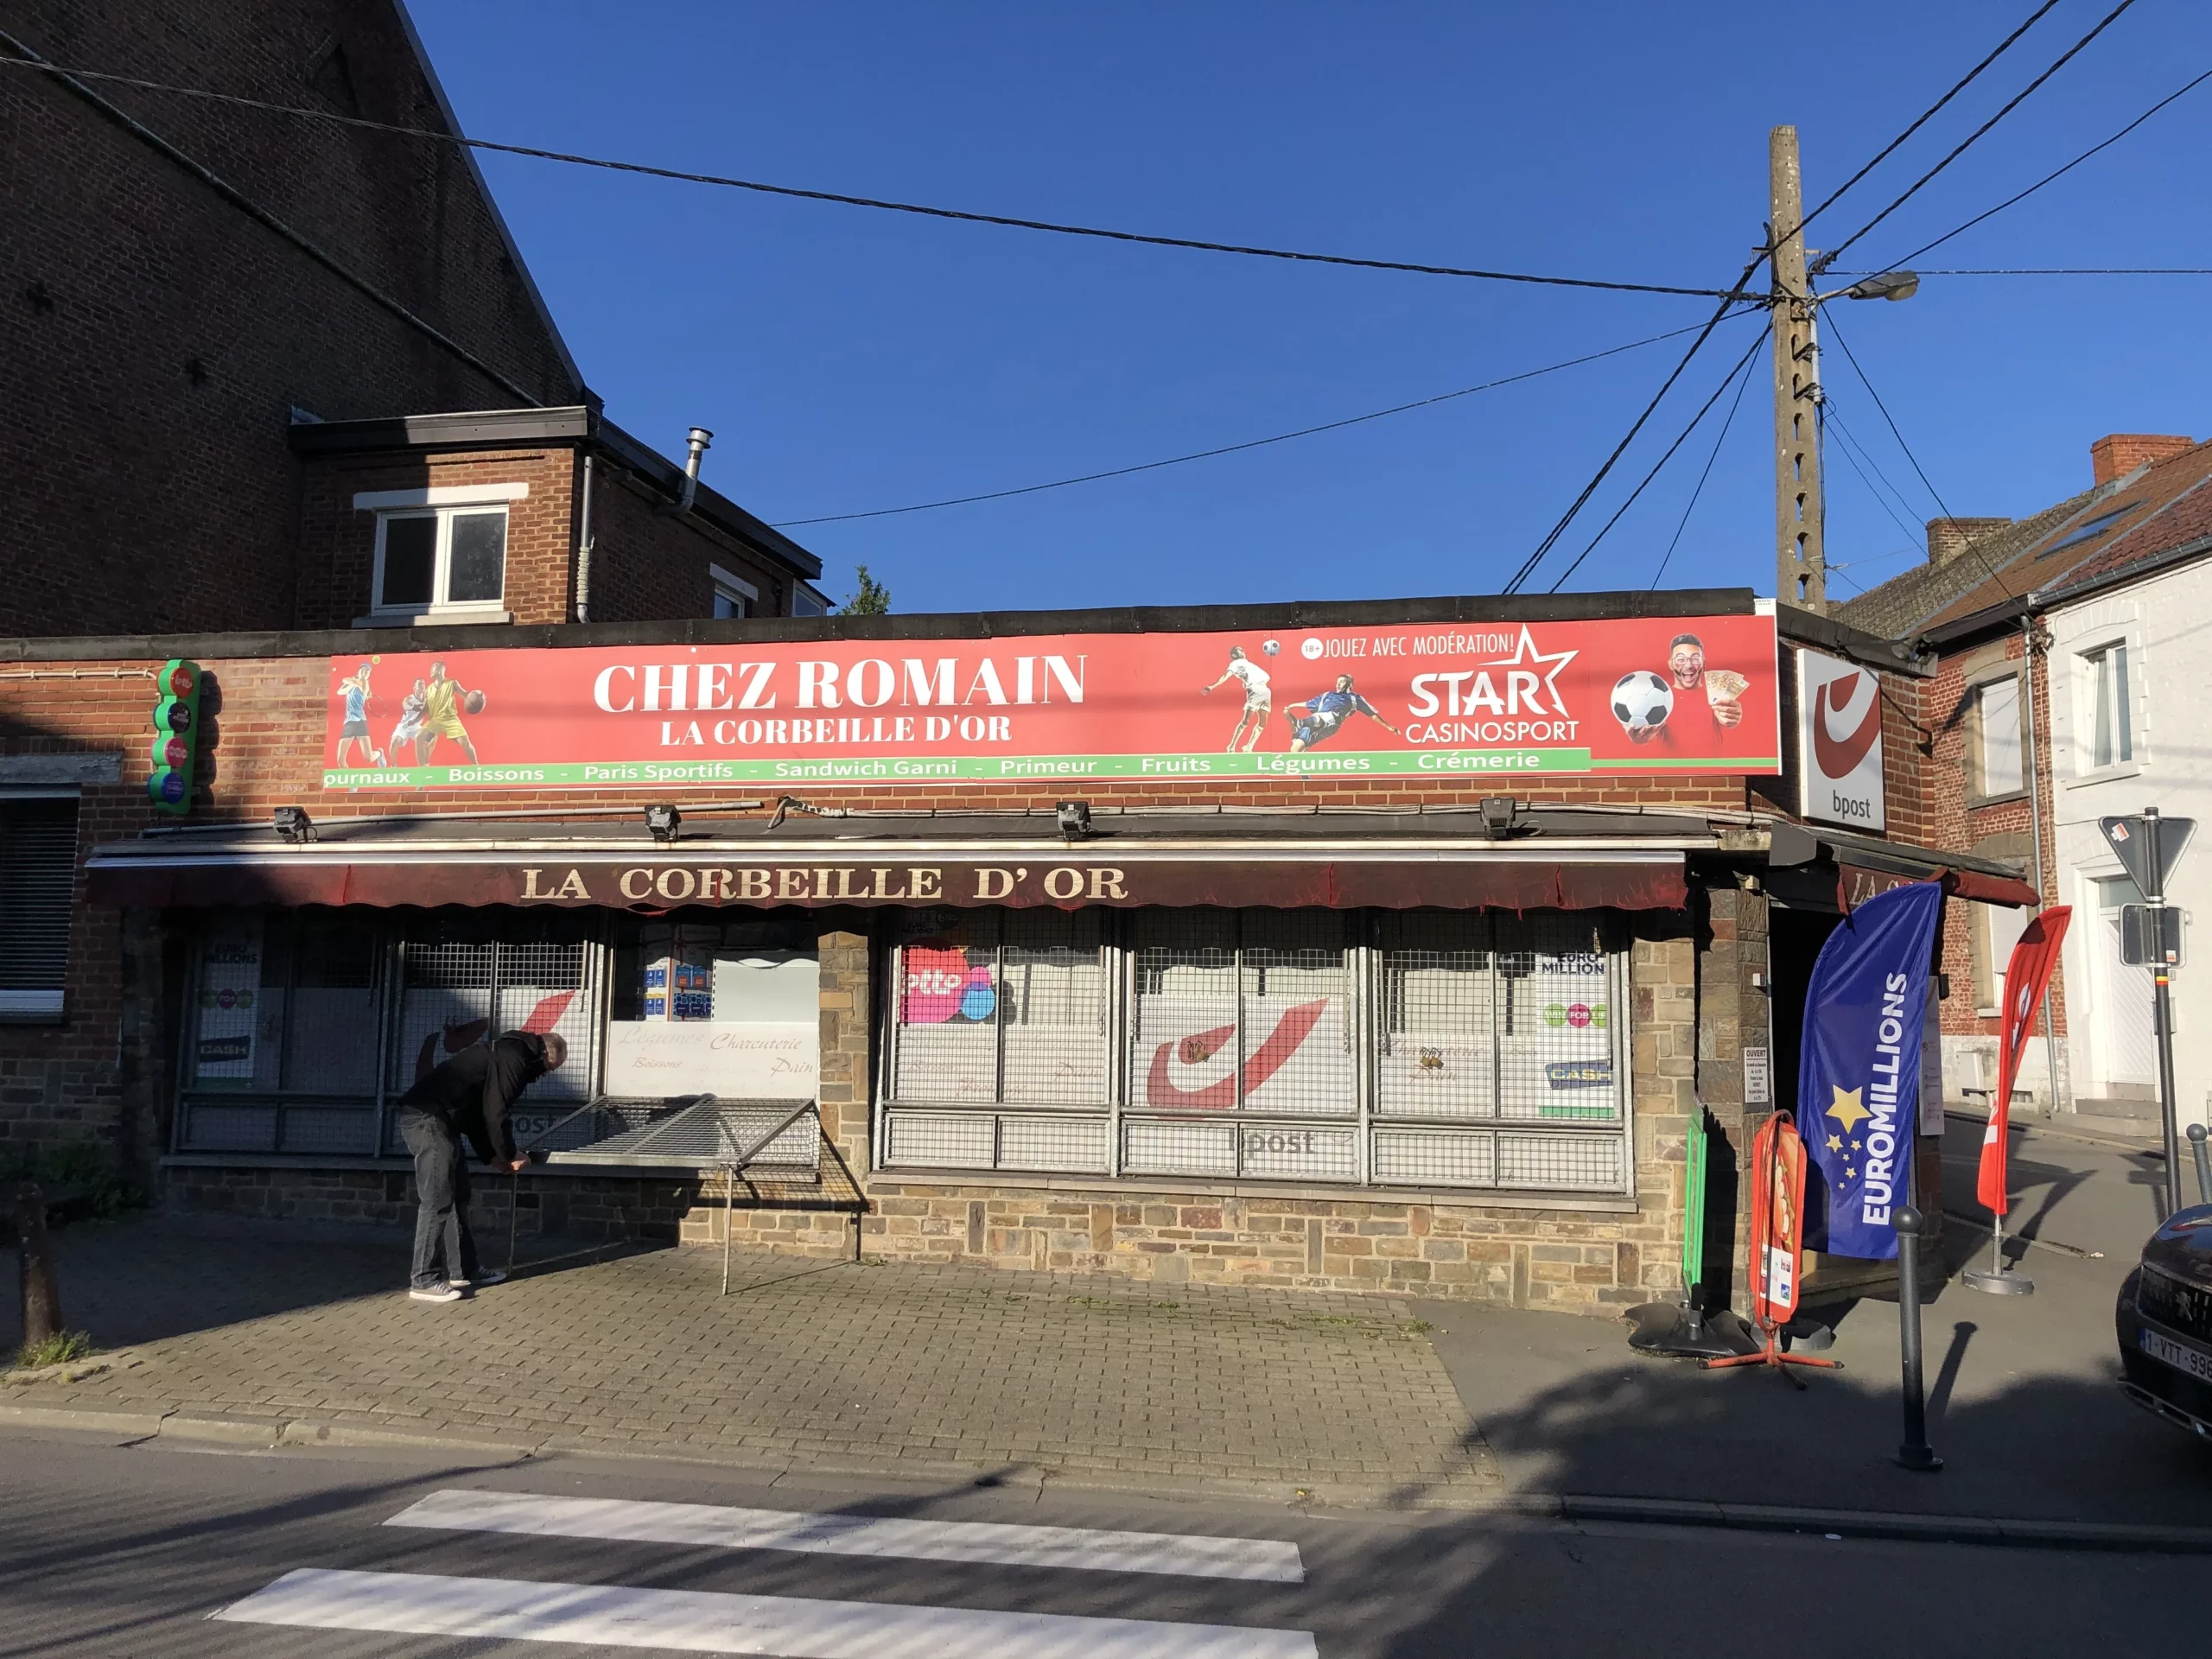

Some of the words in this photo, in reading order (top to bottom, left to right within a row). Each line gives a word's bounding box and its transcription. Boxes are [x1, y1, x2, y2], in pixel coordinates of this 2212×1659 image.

[1323, 638, 1366, 658] JOUEZ
[1372, 636, 1407, 656] AVEC
[1413, 632, 1514, 655] MODÉRATION!
[594, 662, 778, 713] CHEZ
[795, 655, 1088, 709] ROMAIN
[1408, 671, 1549, 717] STAR
[659, 720, 704, 746] LA
[714, 717, 915, 745] CORBEILLE
[925, 715, 1012, 743] D'OR
[1406, 721, 1580, 743] CASINOSPORT
[324, 772, 410, 785] ournaux
[449, 767, 544, 782] Boissons
[585, 765, 638, 779] Paris
[640, 763, 733, 781] Sportifs
[775, 761, 888, 777] Sandwich
[893, 760, 957, 775] Garni
[1001, 759, 1096, 774] Primeur
[1142, 756, 1211, 772] Fruits
[1257, 755, 1370, 774] Légumes
[1418, 751, 1540, 769] Crémerie
[1833, 790, 1871, 818] bpost
[521, 868, 591, 900] LA
[620, 868, 944, 900] CORBEILLE
[1849, 873, 1876, 905] LA
[1542, 963, 1605, 975] MILLION
[1558, 952, 1599, 963] EURO
[617, 1026, 705, 1048] Légumes
[709, 1033, 803, 1051] Charcuterie
[632, 1057, 683, 1069] Boissons
[1746, 1049, 1766, 1058] OUVERT
[771, 1057, 813, 1077] Pain
[1551, 1069, 1611, 1080] CASH
[1863, 972, 1908, 1225] EUROMILLIONS
